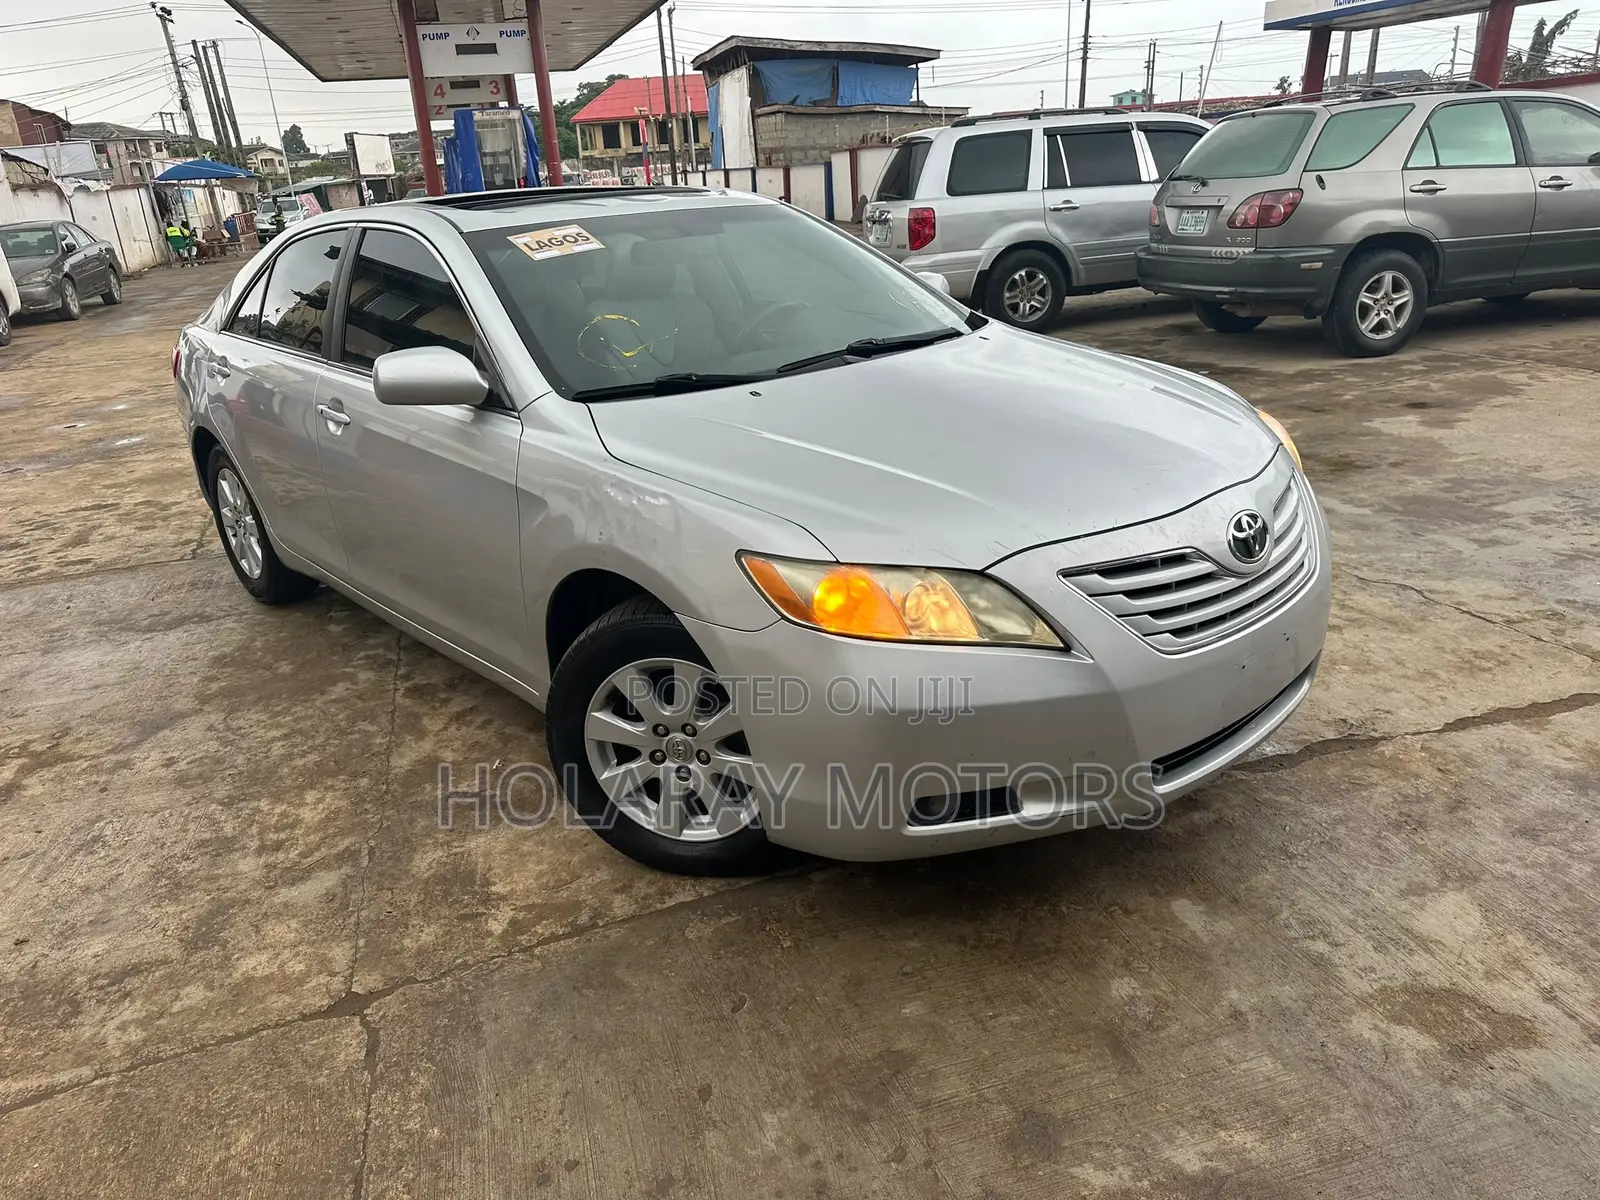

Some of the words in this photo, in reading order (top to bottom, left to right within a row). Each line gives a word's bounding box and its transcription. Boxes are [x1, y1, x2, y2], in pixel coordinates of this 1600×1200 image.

[422, 32, 450, 41] PUMP
[499, 29, 527, 38] PUMP
[434, 84, 446, 98] 4
[489, 80, 500, 95] 3
[523, 232, 591, 252] LAGOS
